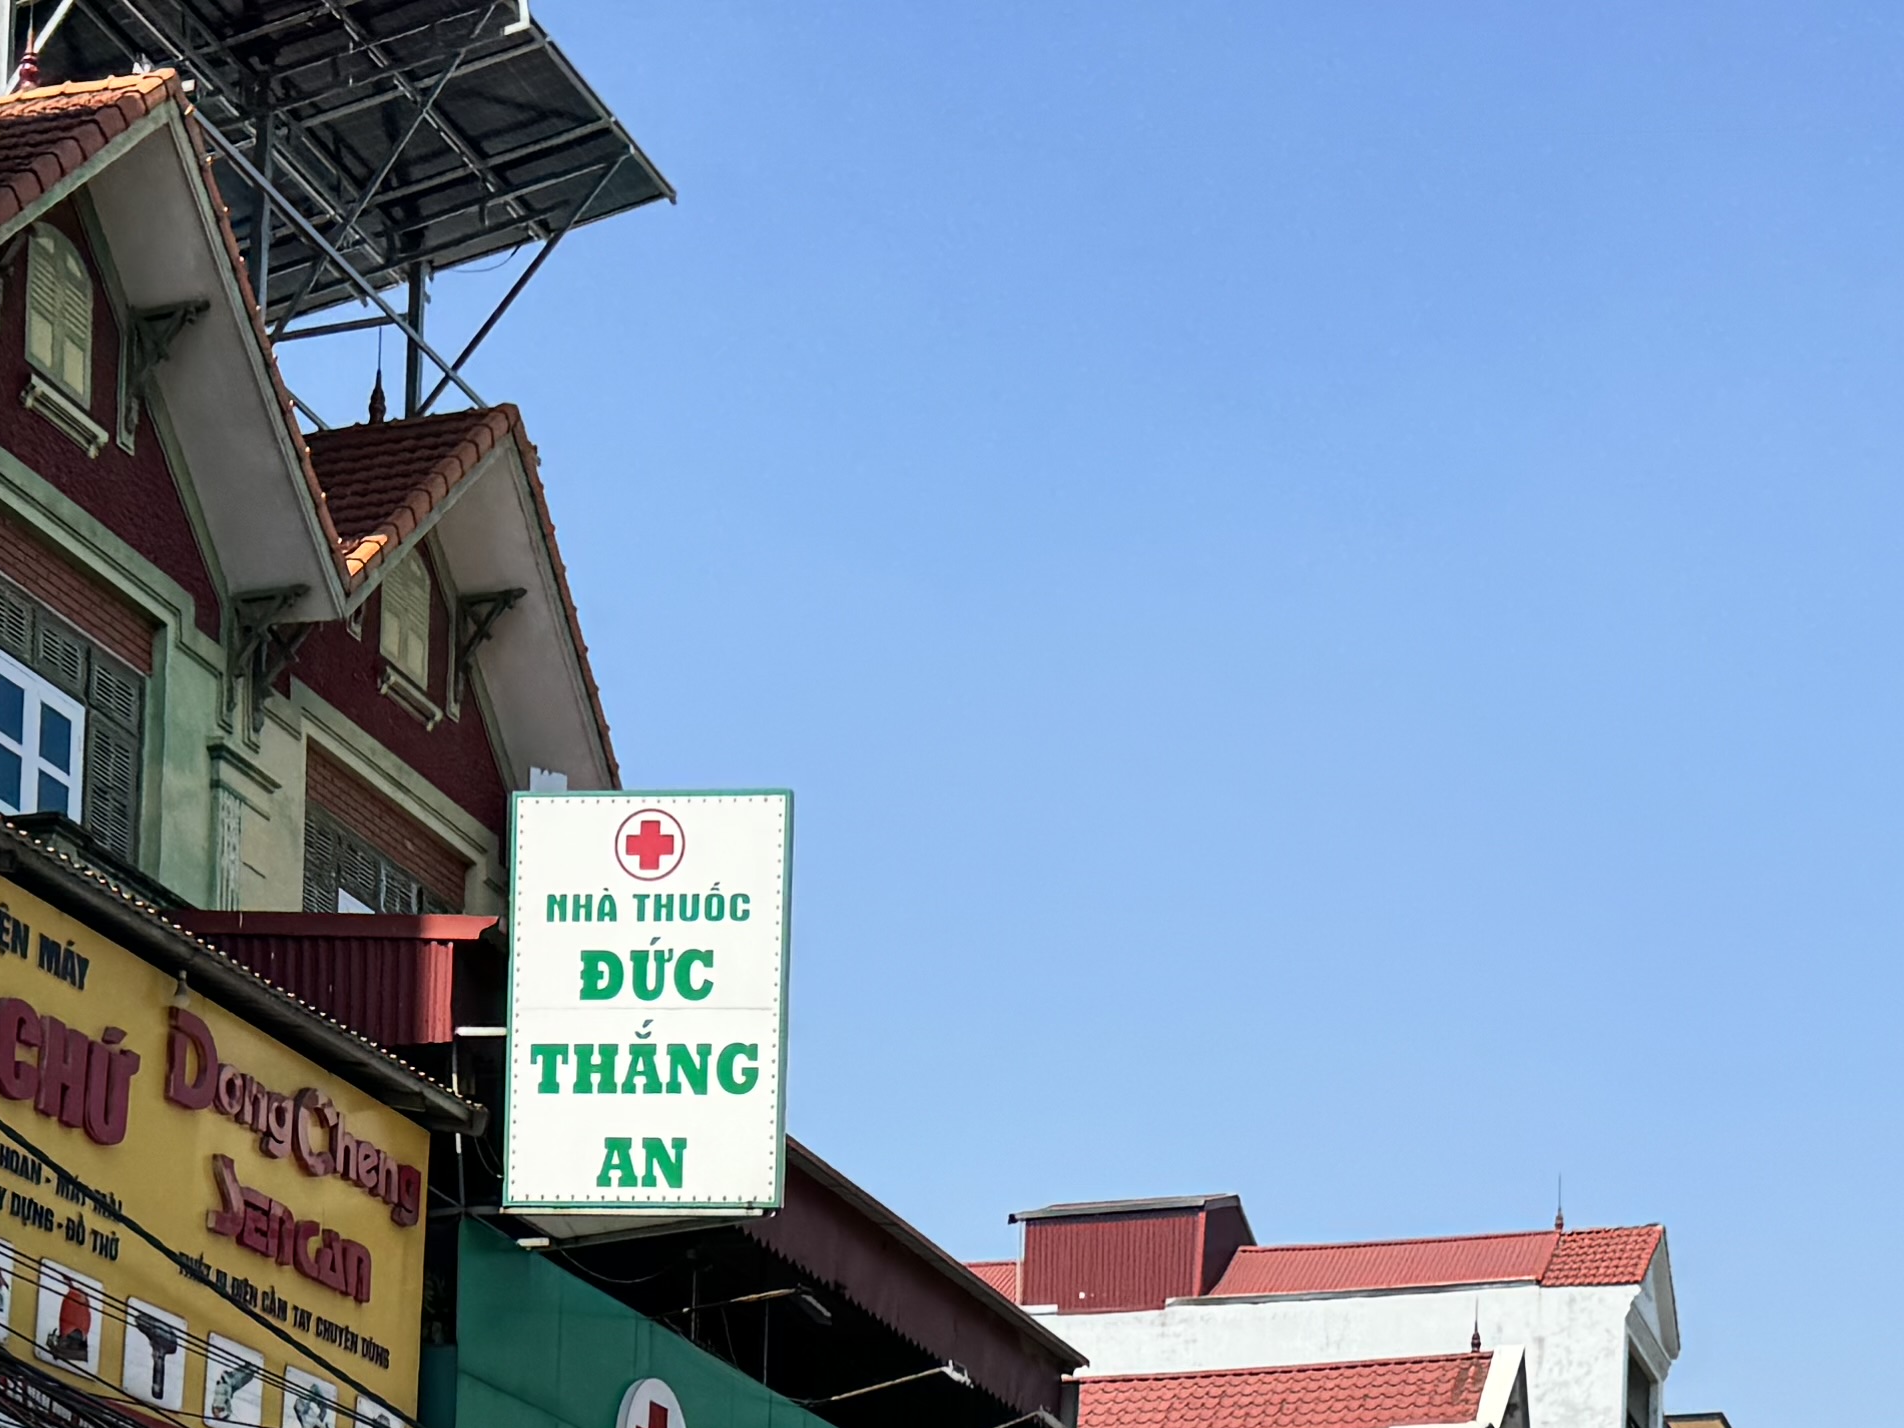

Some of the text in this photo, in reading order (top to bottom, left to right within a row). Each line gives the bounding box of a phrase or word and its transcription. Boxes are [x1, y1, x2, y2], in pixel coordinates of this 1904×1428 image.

[546, 881, 751, 924] NHÀ THUỐC
[38, 931, 89, 991] MÁY
[579, 936, 714, 1002] ĐỨC
[530, 1019, 760, 1096] THẮNG
[596, 1137, 687, 1189] AN
[10, 1191, 54, 1234] DỰNG
[65, 1211, 86, 1248] ĐỒ
[293, 1305, 313, 1333] TAY
[315, 1315, 359, 1357] CHUYÊN
